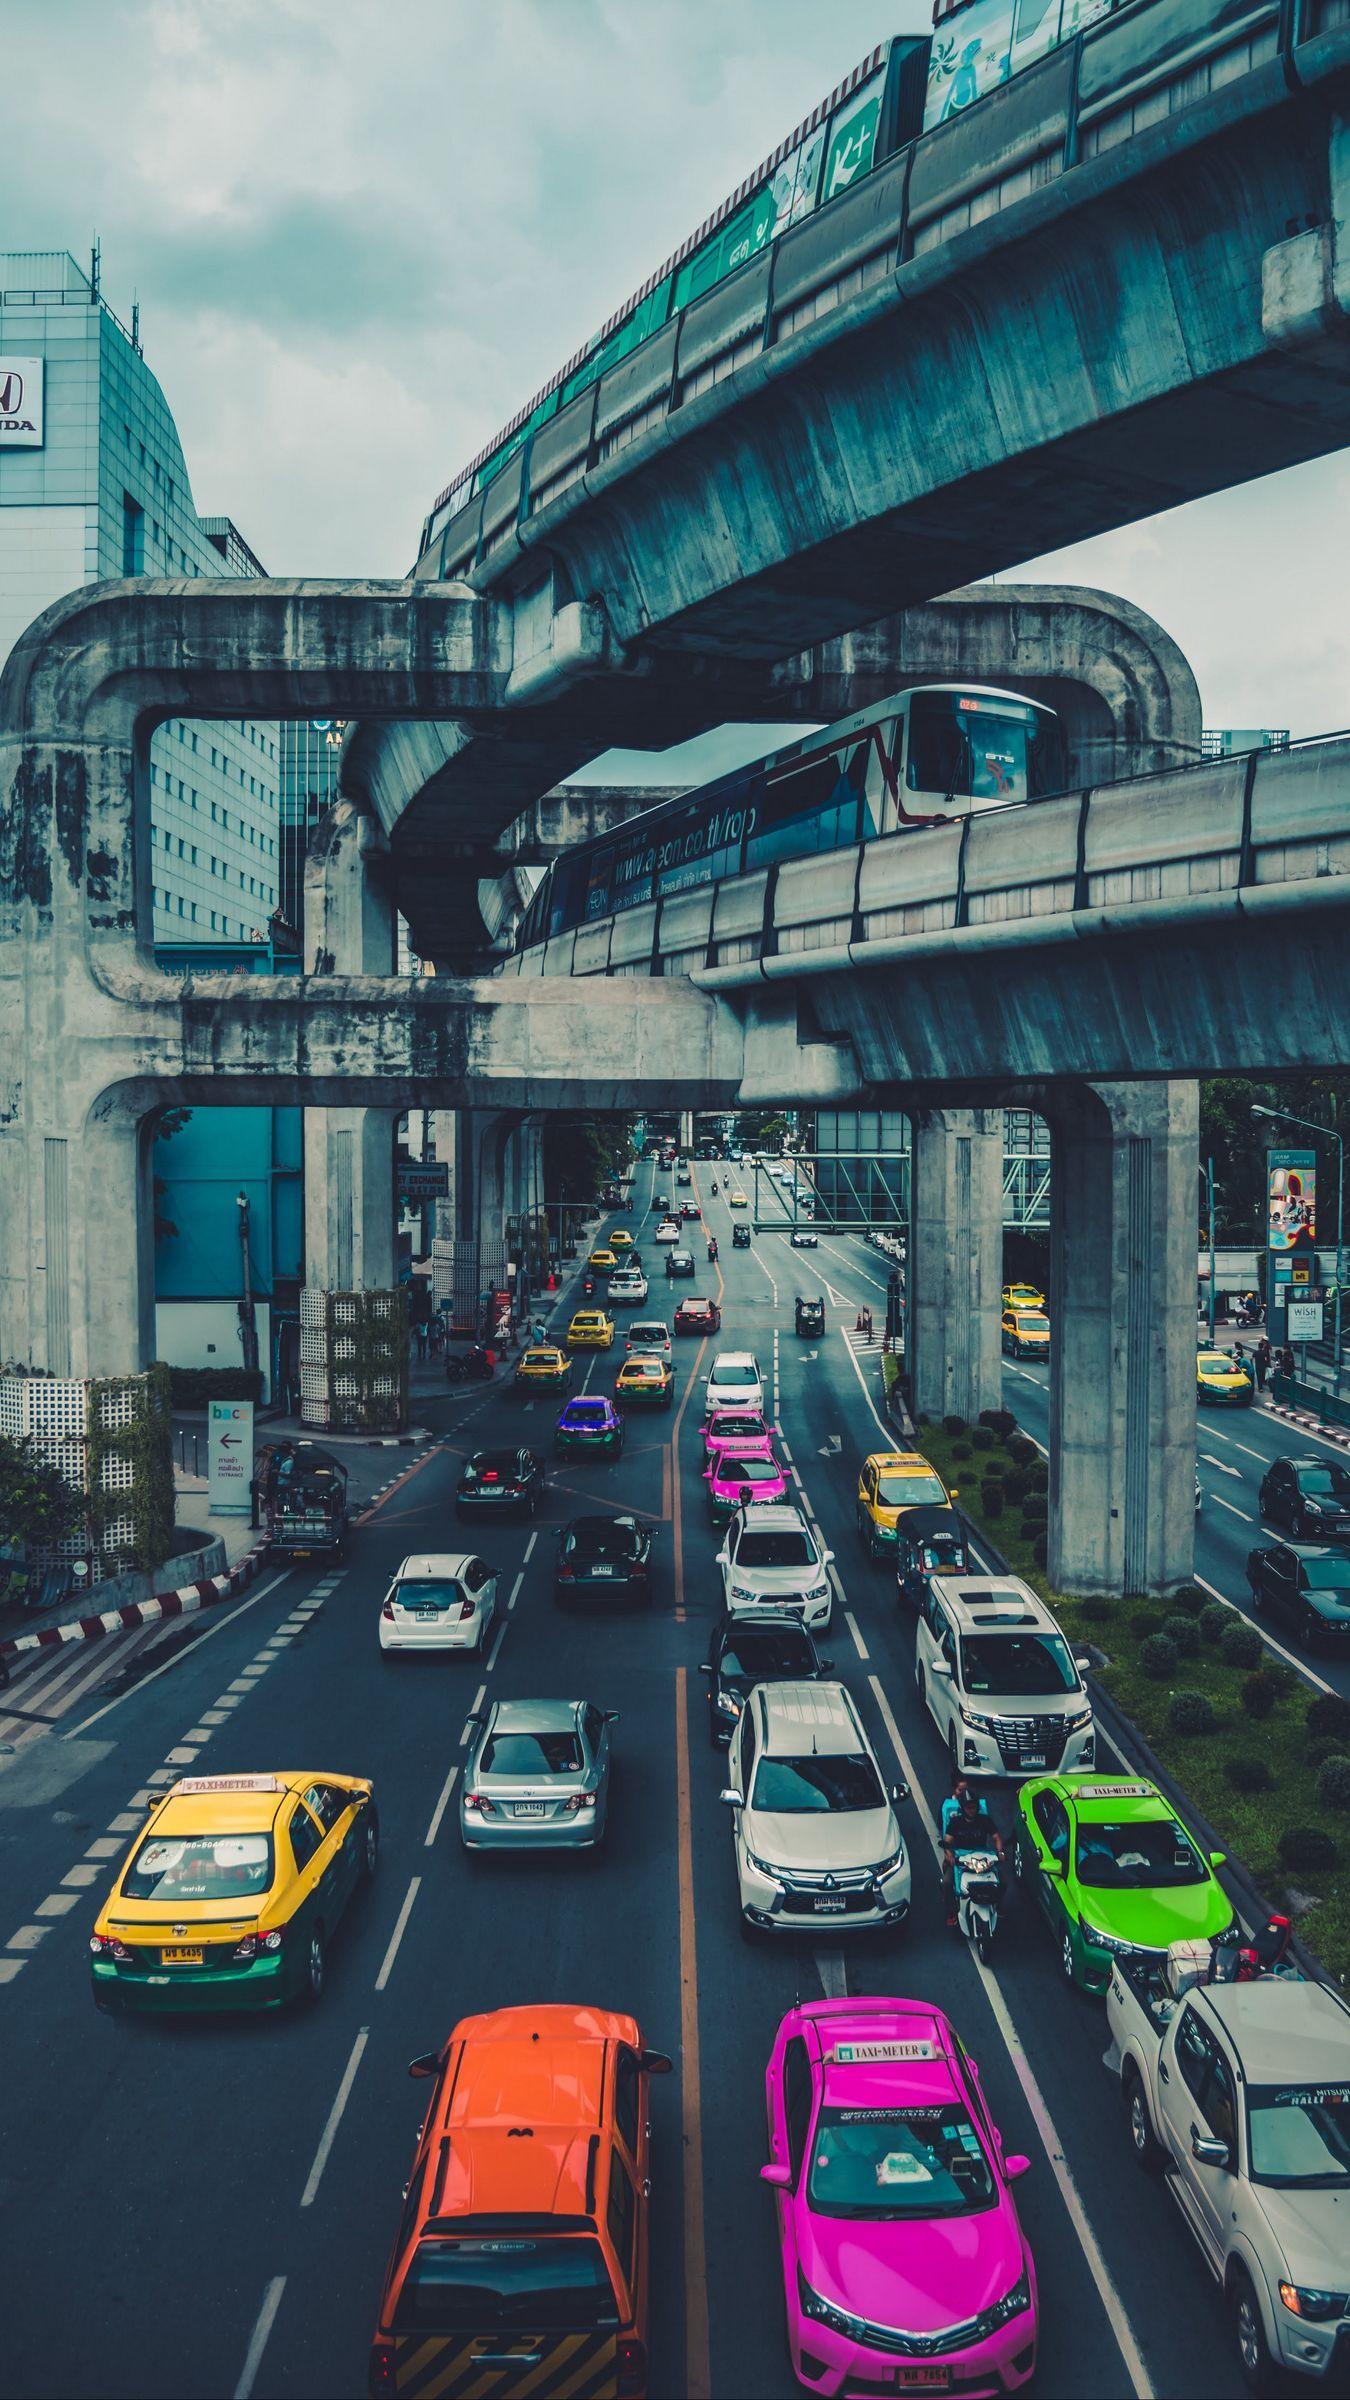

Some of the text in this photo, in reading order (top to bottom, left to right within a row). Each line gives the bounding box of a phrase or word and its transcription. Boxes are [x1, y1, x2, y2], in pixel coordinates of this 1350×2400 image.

[829, 124, 871, 199] K+
[0, 420, 36, 431] DA
[410, 1175, 446, 1184] EXCHANGE
[194, 1780, 254, 1790] TAXI-METER
[1094, 1787, 1137, 1795] TAXI-METER
[855, 2045, 919, 2058] TAXI-METER
